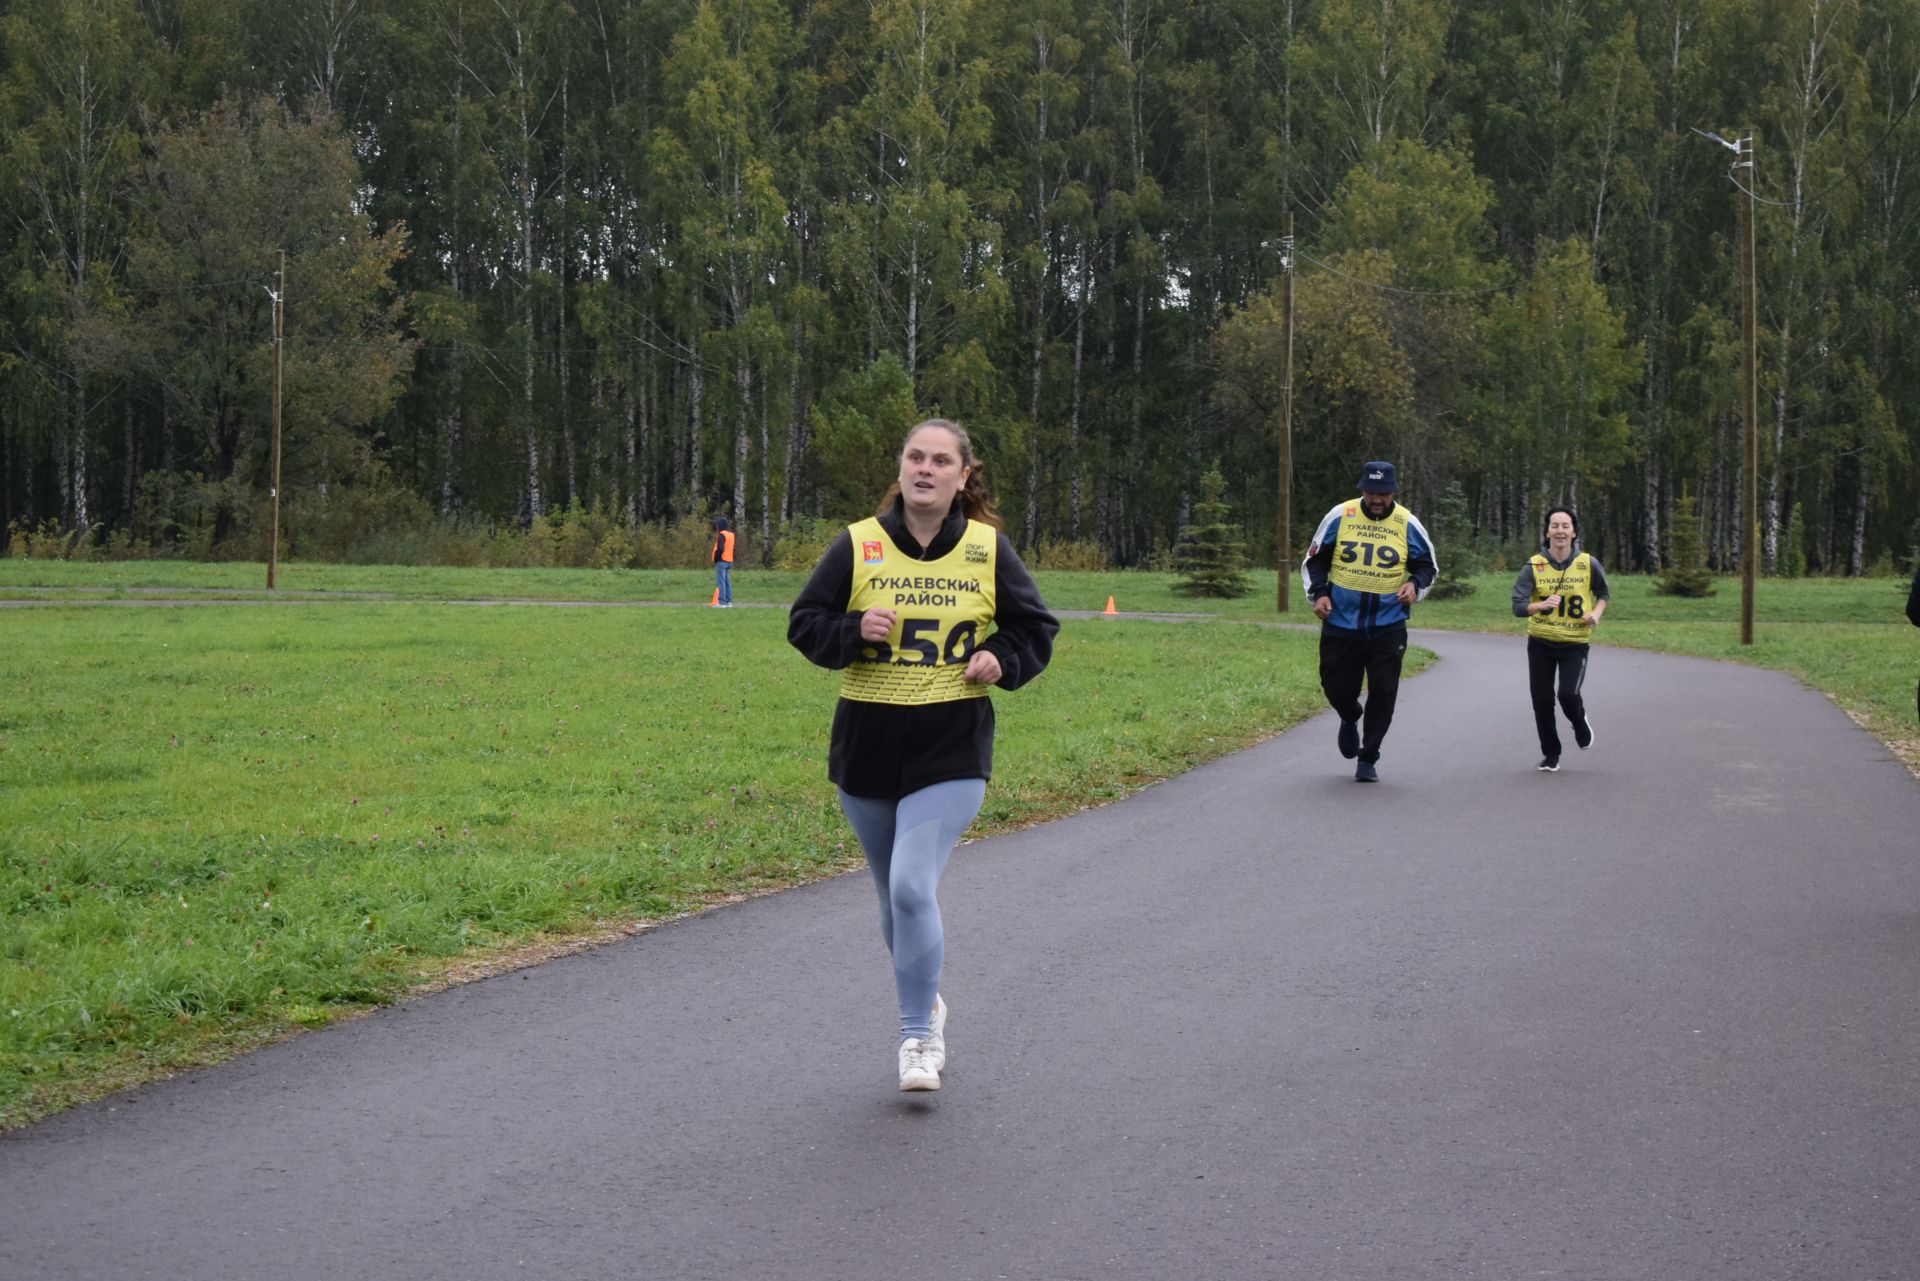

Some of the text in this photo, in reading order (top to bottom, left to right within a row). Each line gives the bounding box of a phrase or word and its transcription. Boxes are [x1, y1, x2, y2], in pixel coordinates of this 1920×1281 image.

[1347, 524, 1399, 537] ТУКАЕВСКИЙ
[1357, 531, 1387, 540] РАЙОН
[965, 543, 984, 551] СПОРТ
[965, 550, 988, 558] НОРМА
[1340, 541, 1400, 569] 319
[1352, 569, 1381, 578] НОРМА
[869, 577, 981, 593] ТУКАЕВСКИЙ
[1539, 576, 1585, 585] ТУКАЕВСКИЙ
[894, 591, 957, 607] РАЙОН
